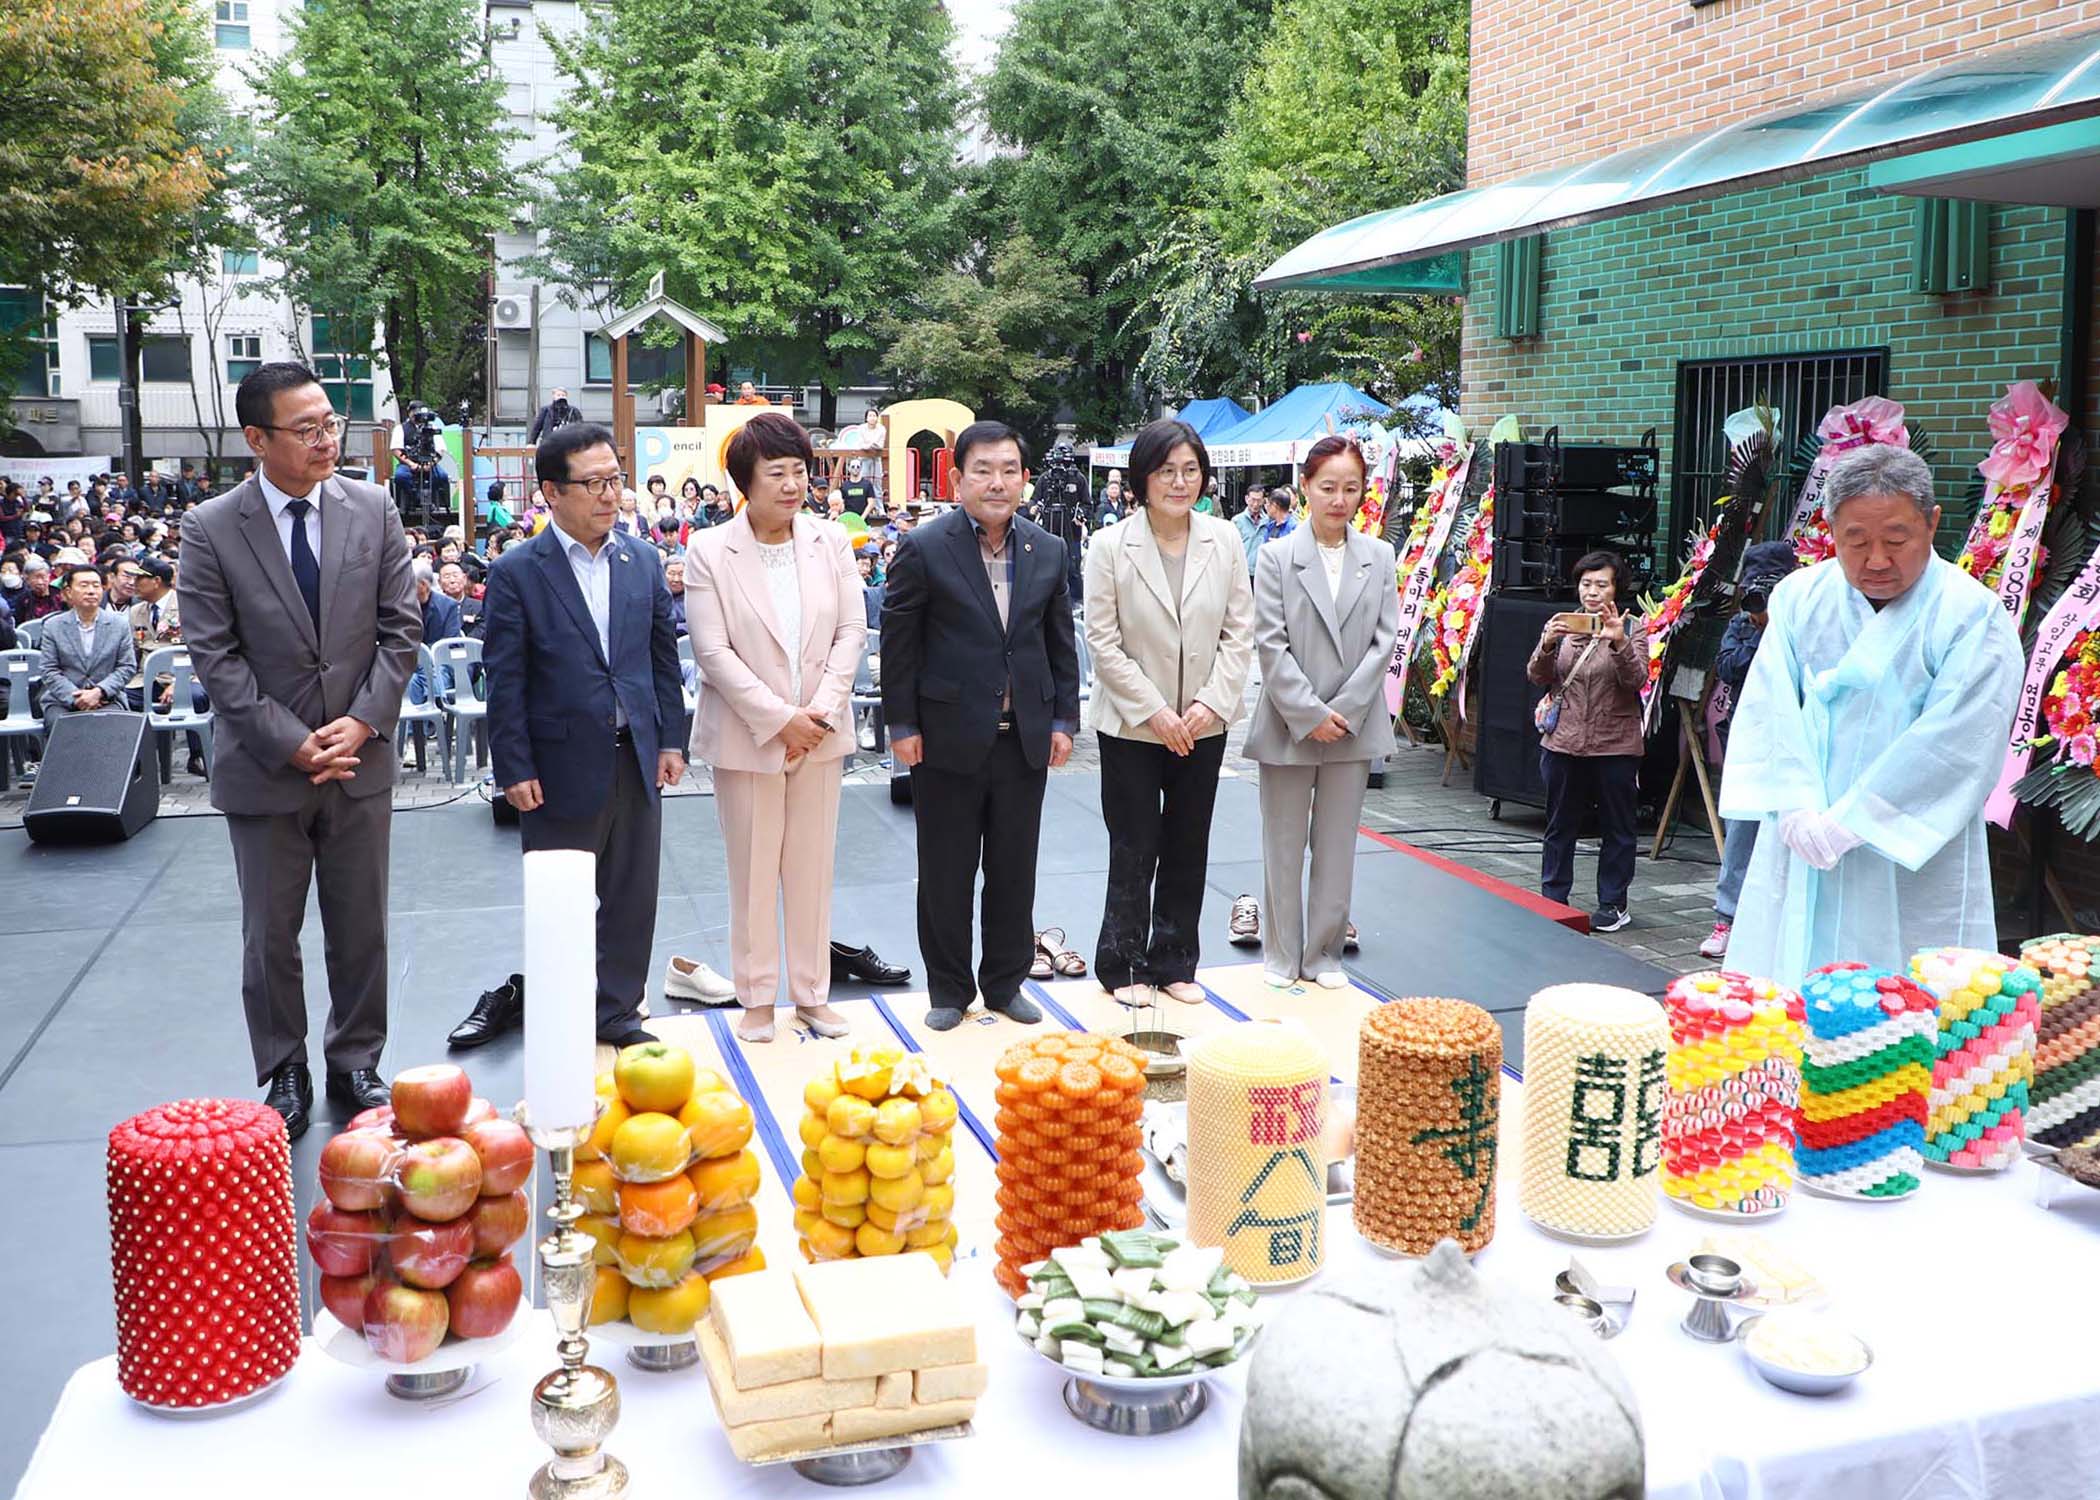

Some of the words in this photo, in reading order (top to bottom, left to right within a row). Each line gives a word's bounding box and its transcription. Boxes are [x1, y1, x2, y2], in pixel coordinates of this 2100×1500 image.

[636, 427, 702, 485] Pencil
[1404, 567, 1429, 619] 돌마리
[2002, 522, 2042, 617] 제38회
[1386, 627, 1411, 679] 대동제
